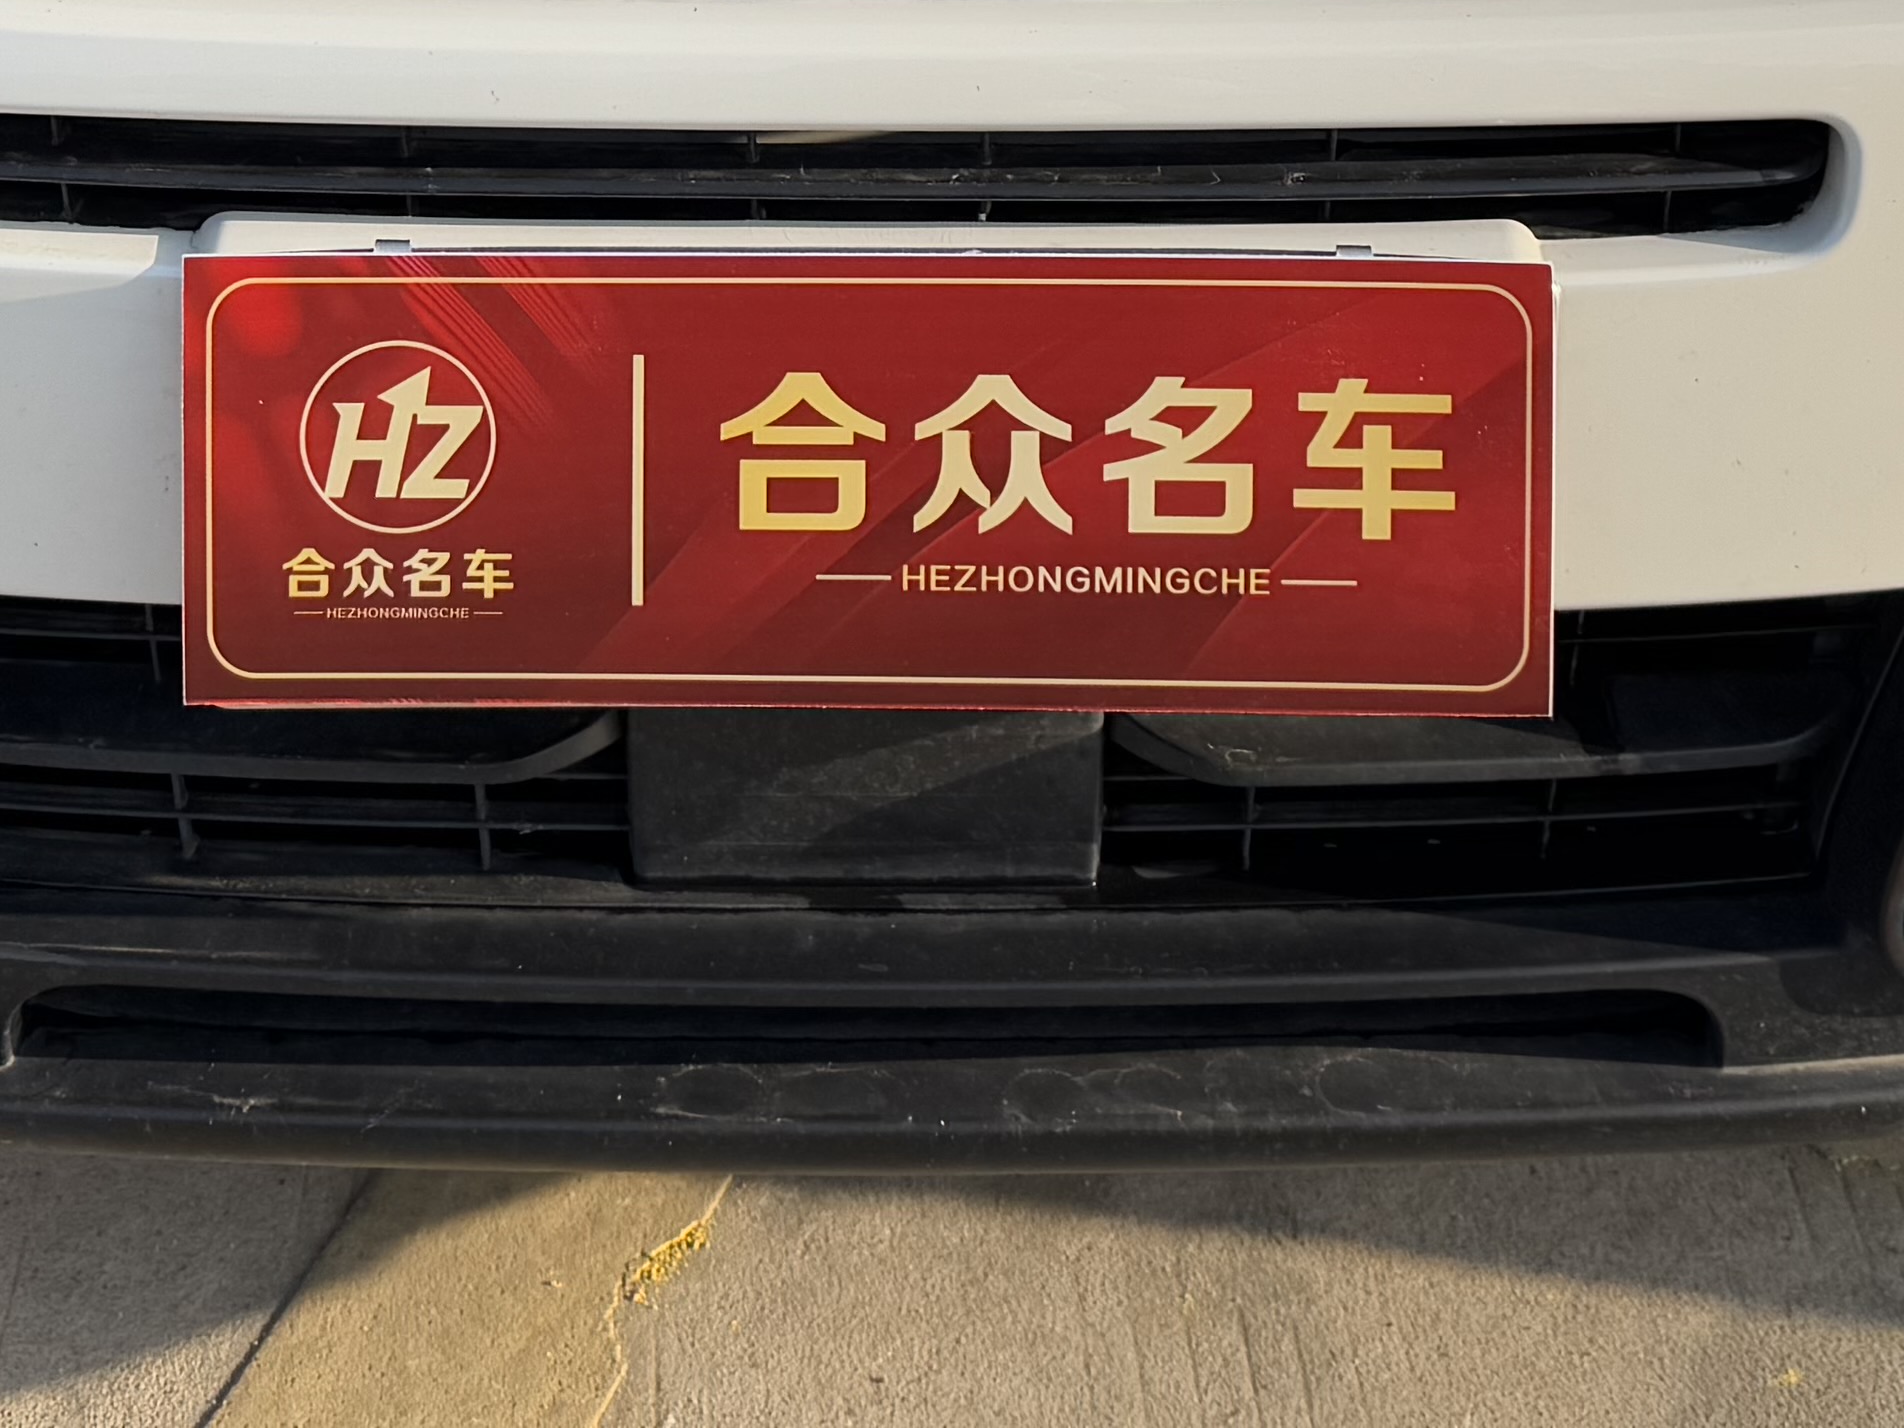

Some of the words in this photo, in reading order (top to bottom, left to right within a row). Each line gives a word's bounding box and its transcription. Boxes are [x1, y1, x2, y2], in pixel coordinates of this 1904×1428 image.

[720, 371, 1456, 541] 合众名车
[282, 548, 514, 599] 合众名车
[901, 563, 1271, 596] HEZHONGMINGCHE
[325, 606, 470, 620] HEZHONGMINGCHE
